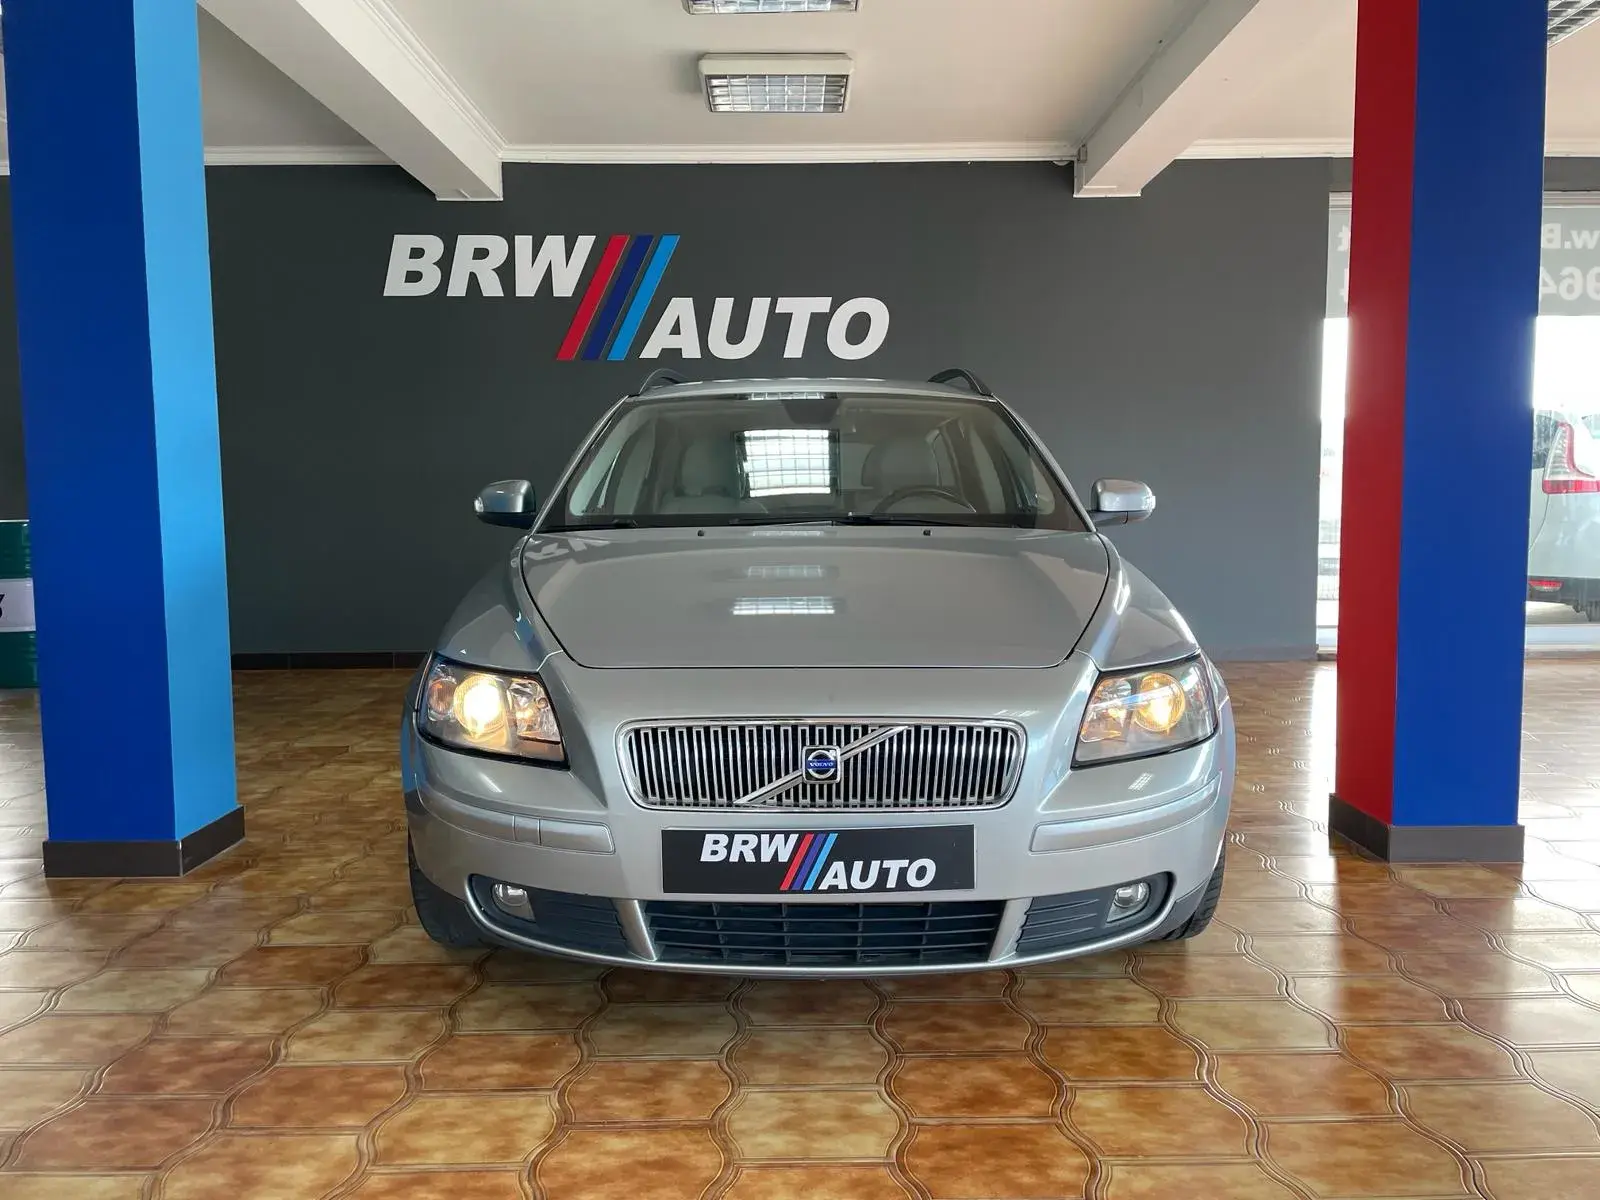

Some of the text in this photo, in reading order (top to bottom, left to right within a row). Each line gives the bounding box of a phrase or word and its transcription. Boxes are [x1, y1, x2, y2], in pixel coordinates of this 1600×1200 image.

[383, 234, 596, 297] BRW
[639, 297, 890, 360] AUTO
[700, 833, 798, 862] BRW
[819, 858, 936, 890] AUTO
